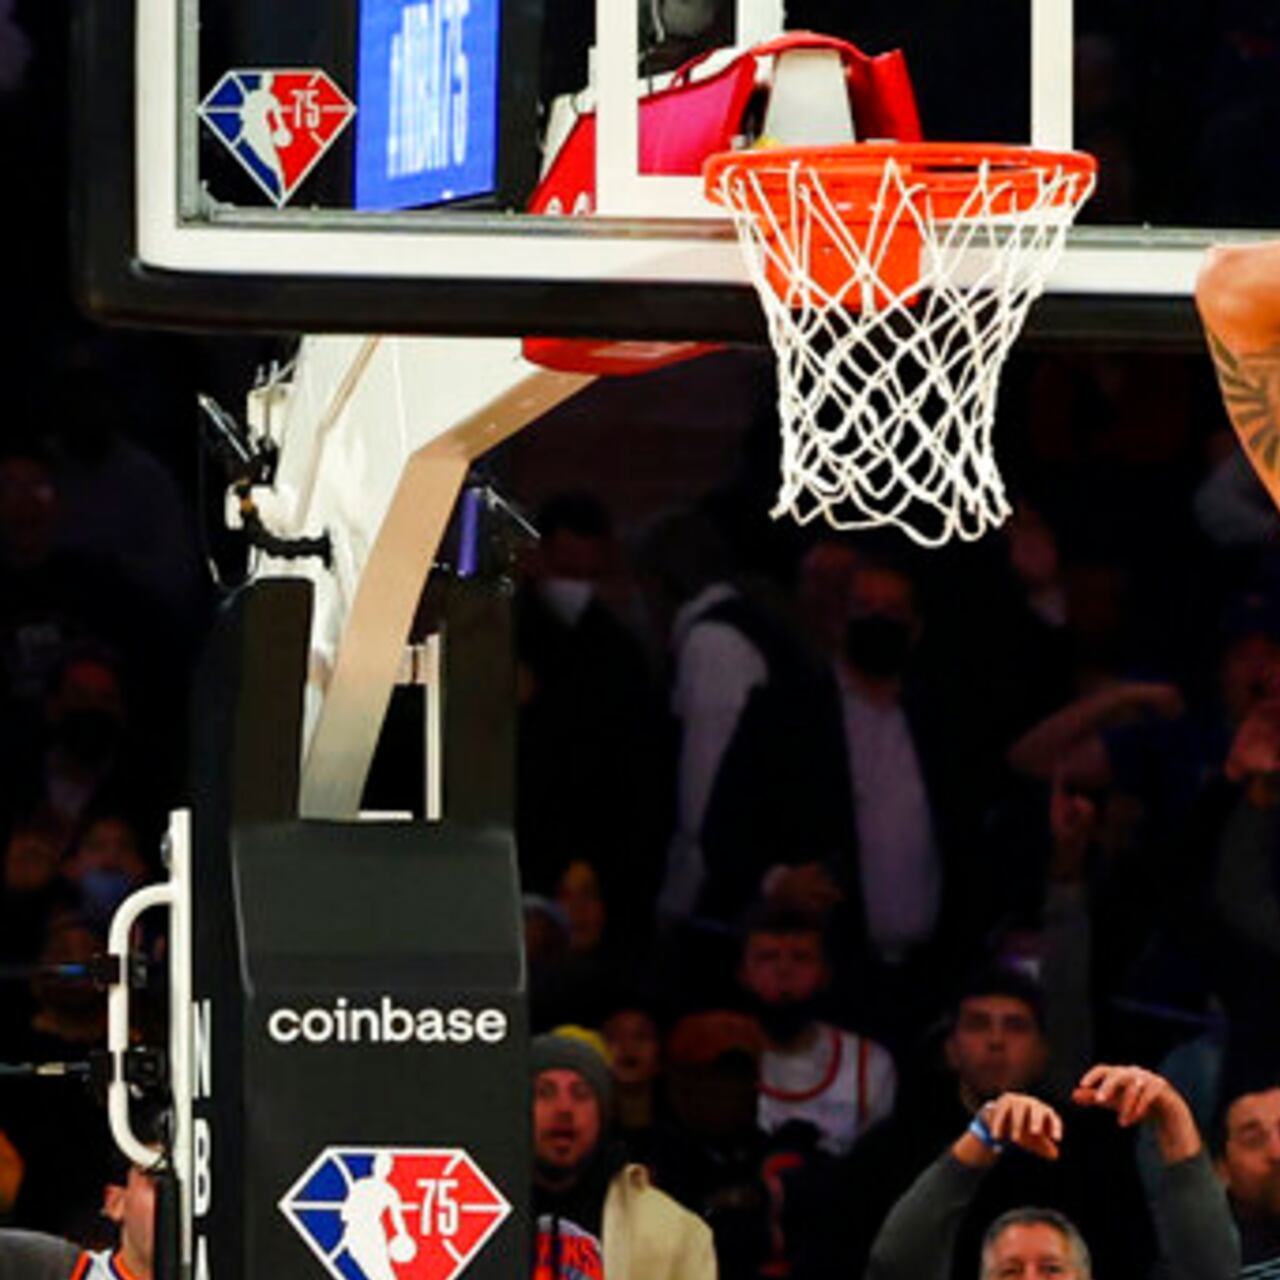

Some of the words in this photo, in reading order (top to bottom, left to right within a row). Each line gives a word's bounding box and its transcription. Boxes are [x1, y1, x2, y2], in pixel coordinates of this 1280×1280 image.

[291, 89, 319, 128] 75
[267, 996, 507, 1043] coinbase
[416, 1179, 460, 1236] 75
